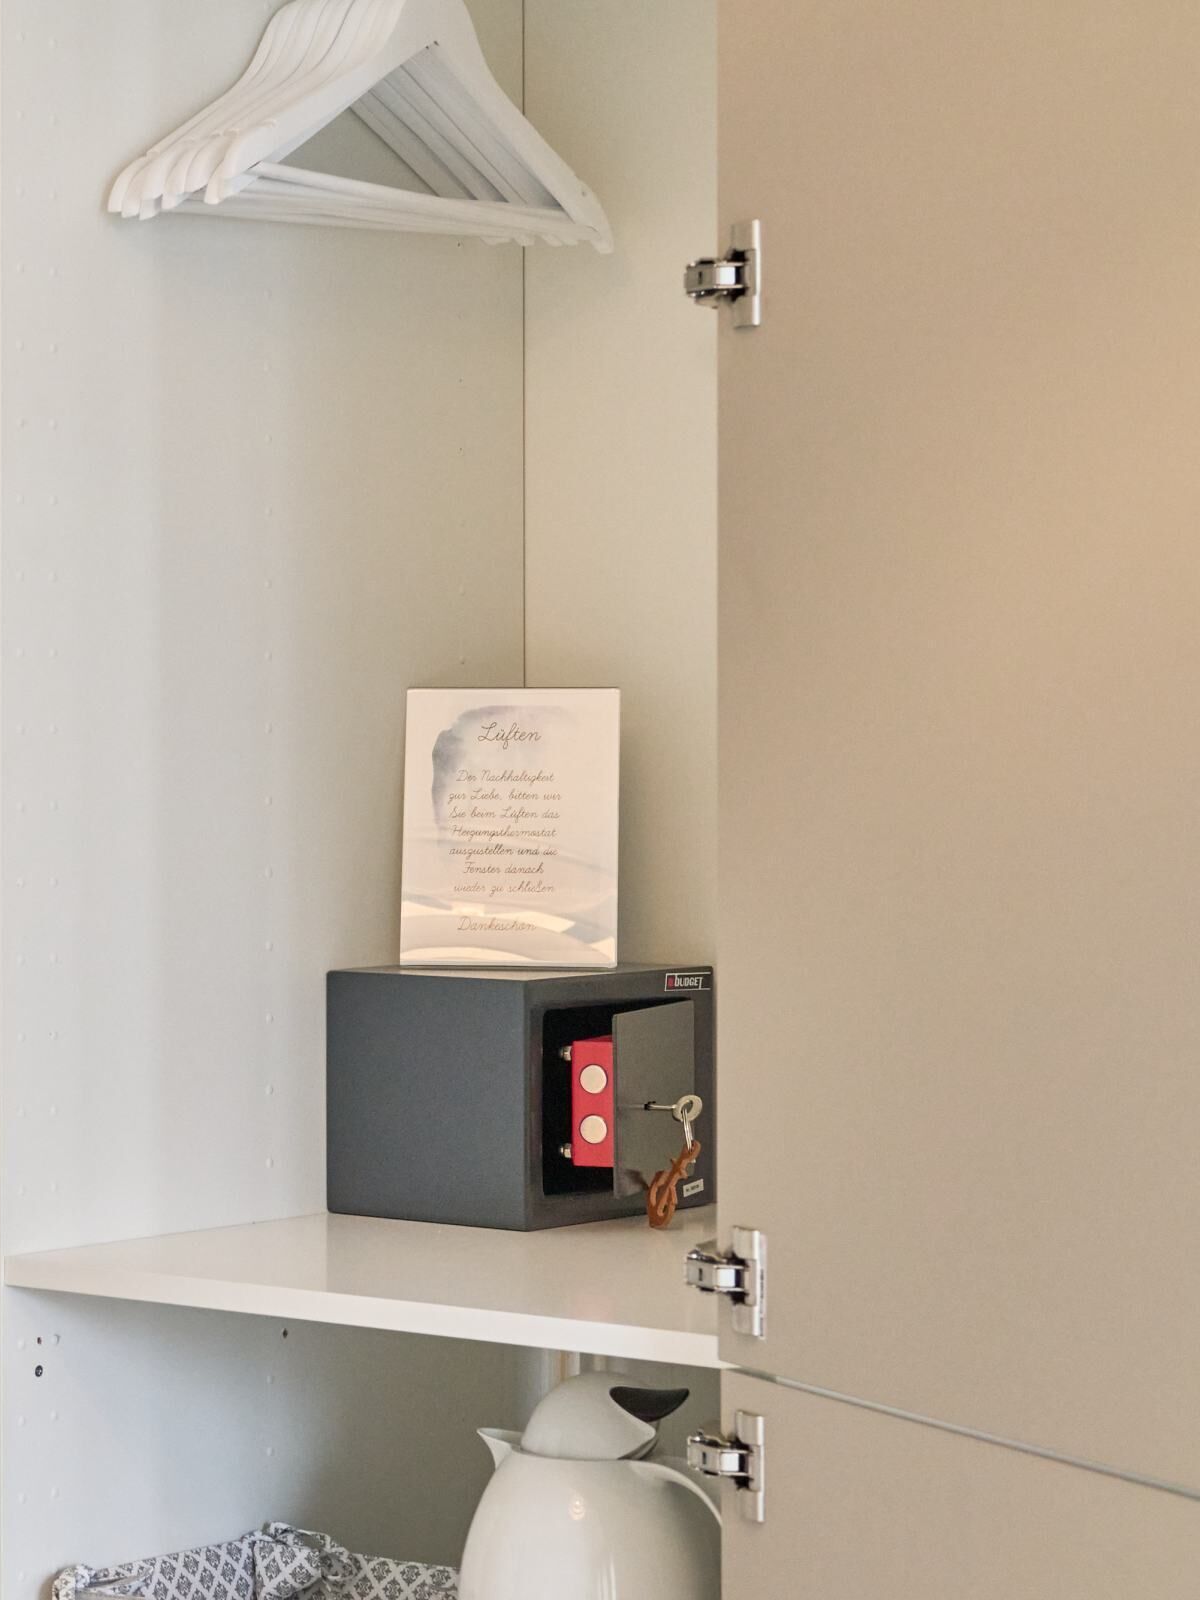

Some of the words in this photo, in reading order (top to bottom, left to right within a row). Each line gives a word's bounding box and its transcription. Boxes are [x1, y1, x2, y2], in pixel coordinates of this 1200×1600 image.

[477, 721, 542, 750] Lüften
[470, 806, 496, 819] beim
[463, 861, 501, 874] Fenster
[504, 861, 544, 874] danach
